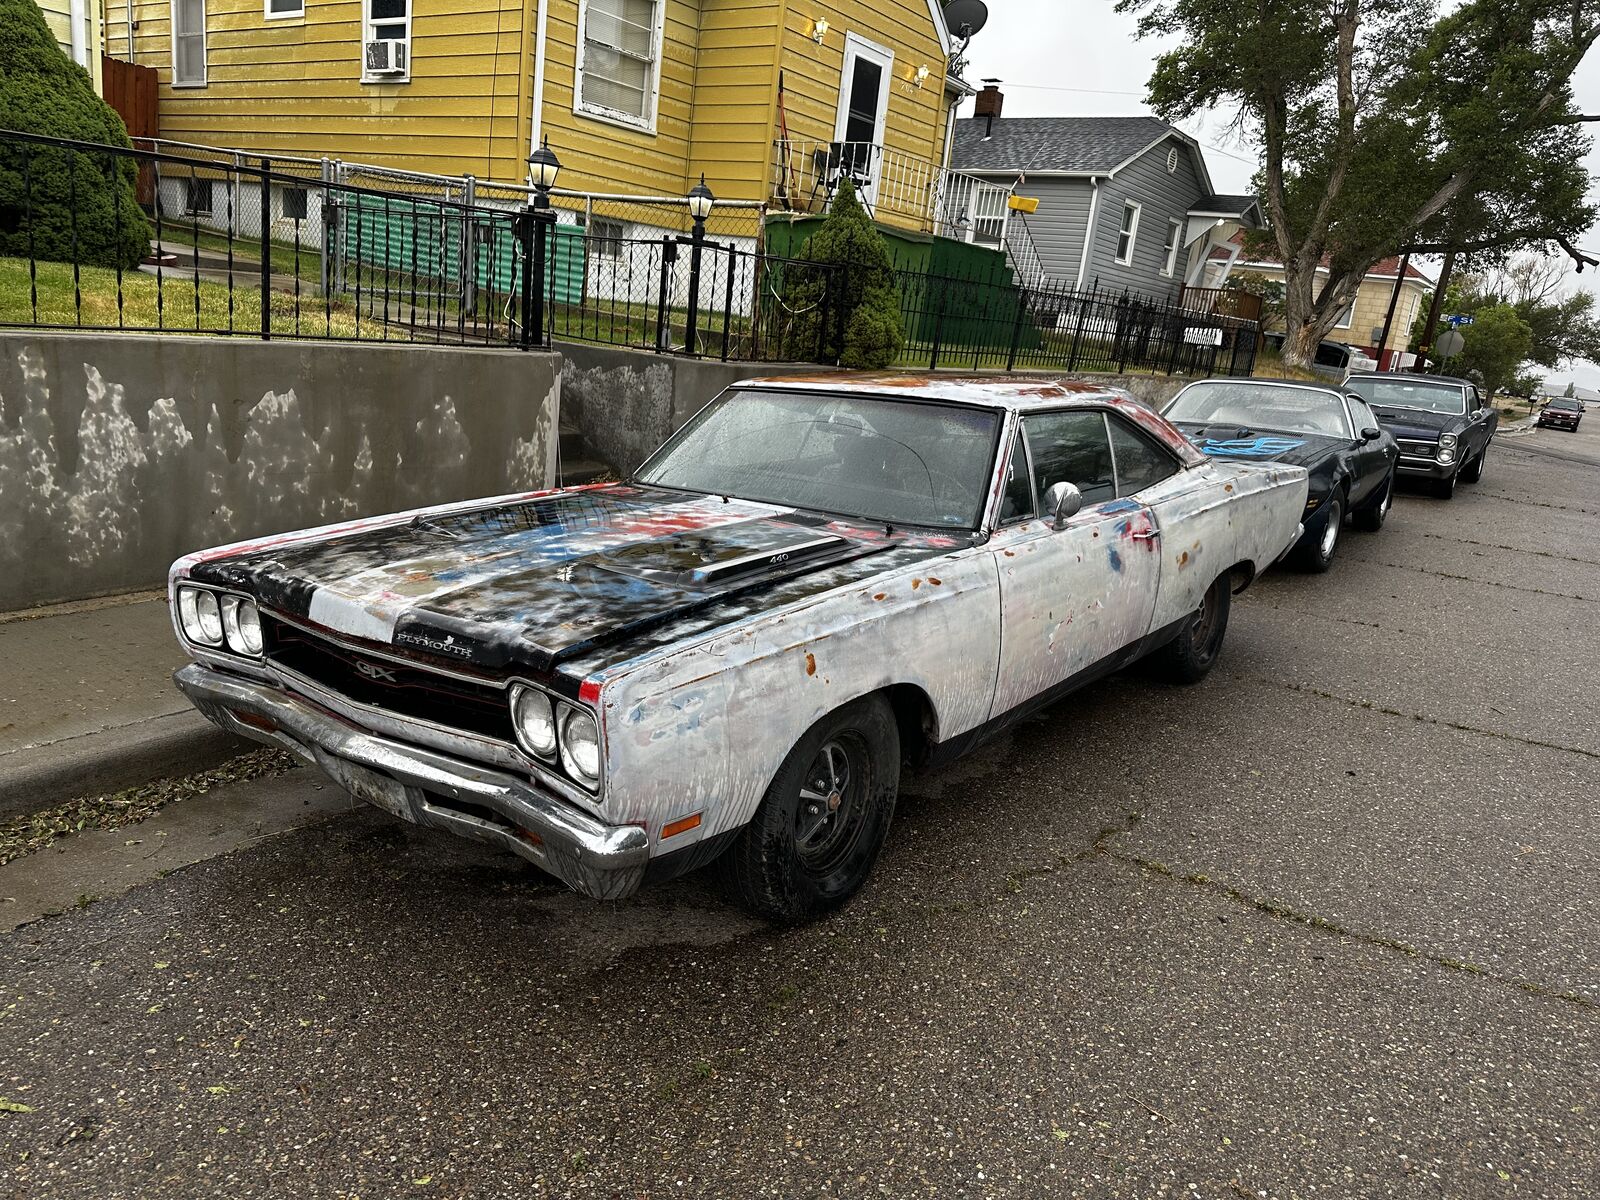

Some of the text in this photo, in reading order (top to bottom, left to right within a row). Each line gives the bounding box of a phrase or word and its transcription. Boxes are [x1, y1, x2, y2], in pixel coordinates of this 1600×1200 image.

[1460, 316, 1474, 325] St
[770, 553, 789, 564] 440
[396, 633, 473, 657] PLYMOUTH
[356, 660, 397, 682] GTX
